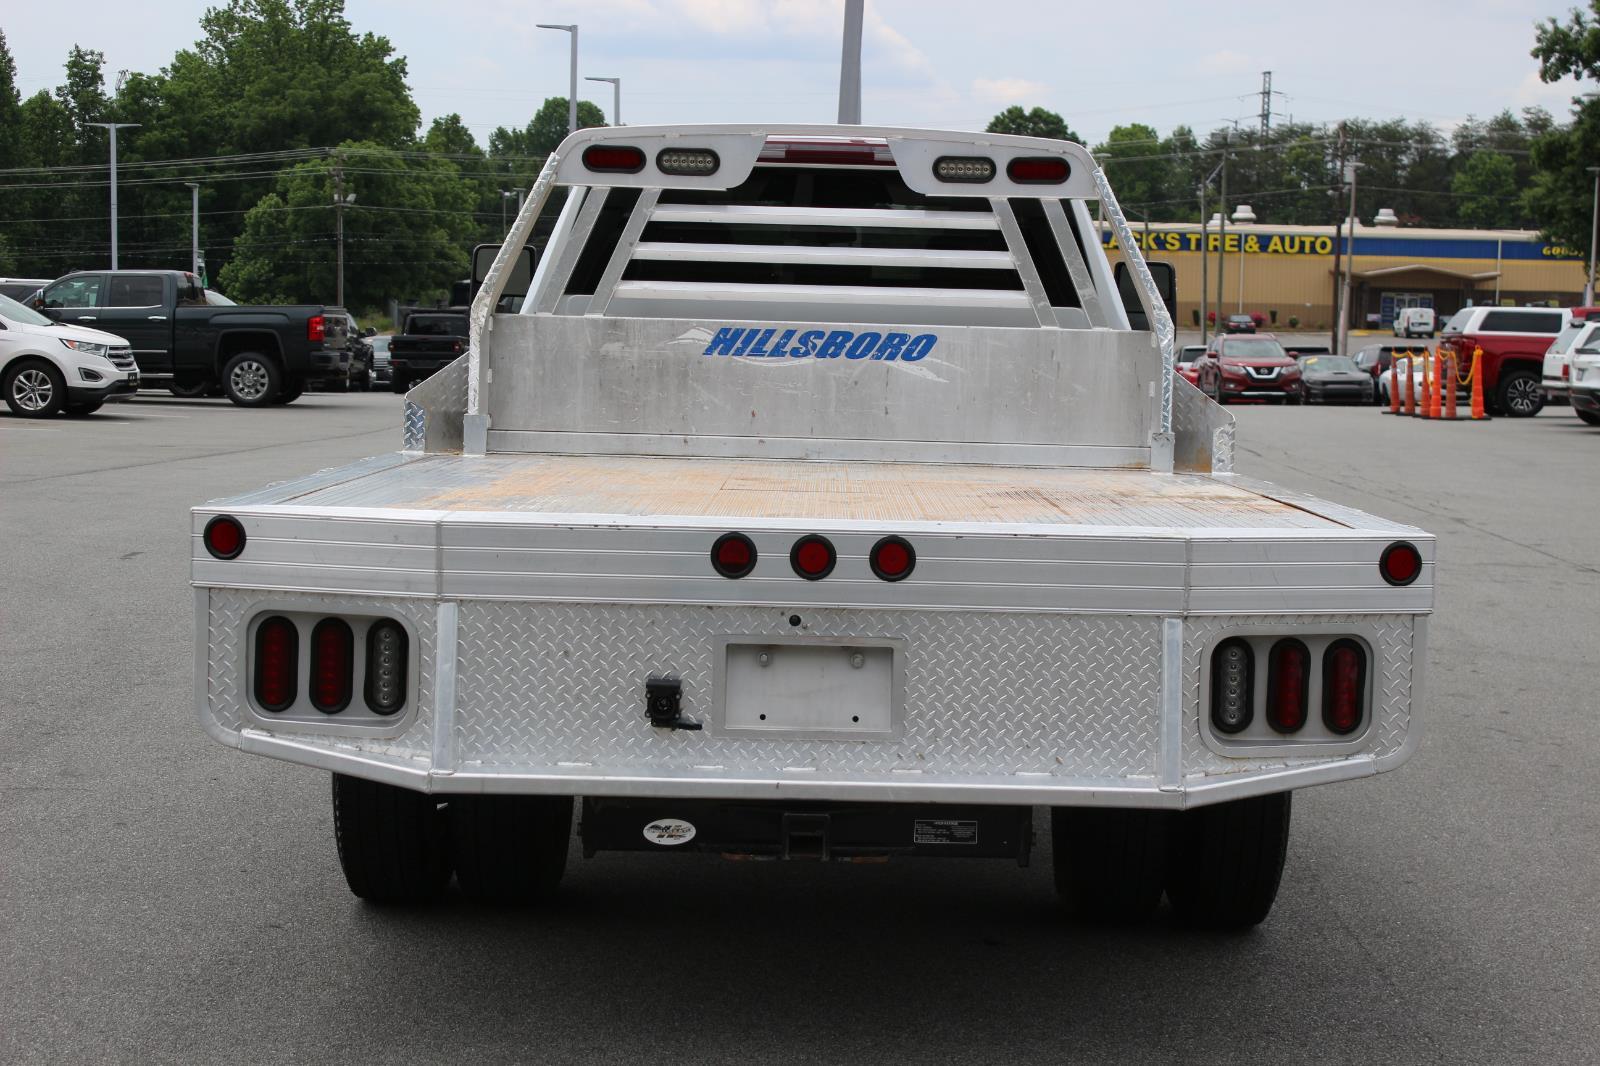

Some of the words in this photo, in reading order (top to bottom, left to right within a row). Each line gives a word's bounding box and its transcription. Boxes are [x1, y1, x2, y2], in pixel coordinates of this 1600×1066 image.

[1186, 233, 1239, 251] TRE
[1245, 235, 1260, 252] &
[1268, 235, 1332, 254] AUTO
[702, 327, 938, 361] HILLSBORO
